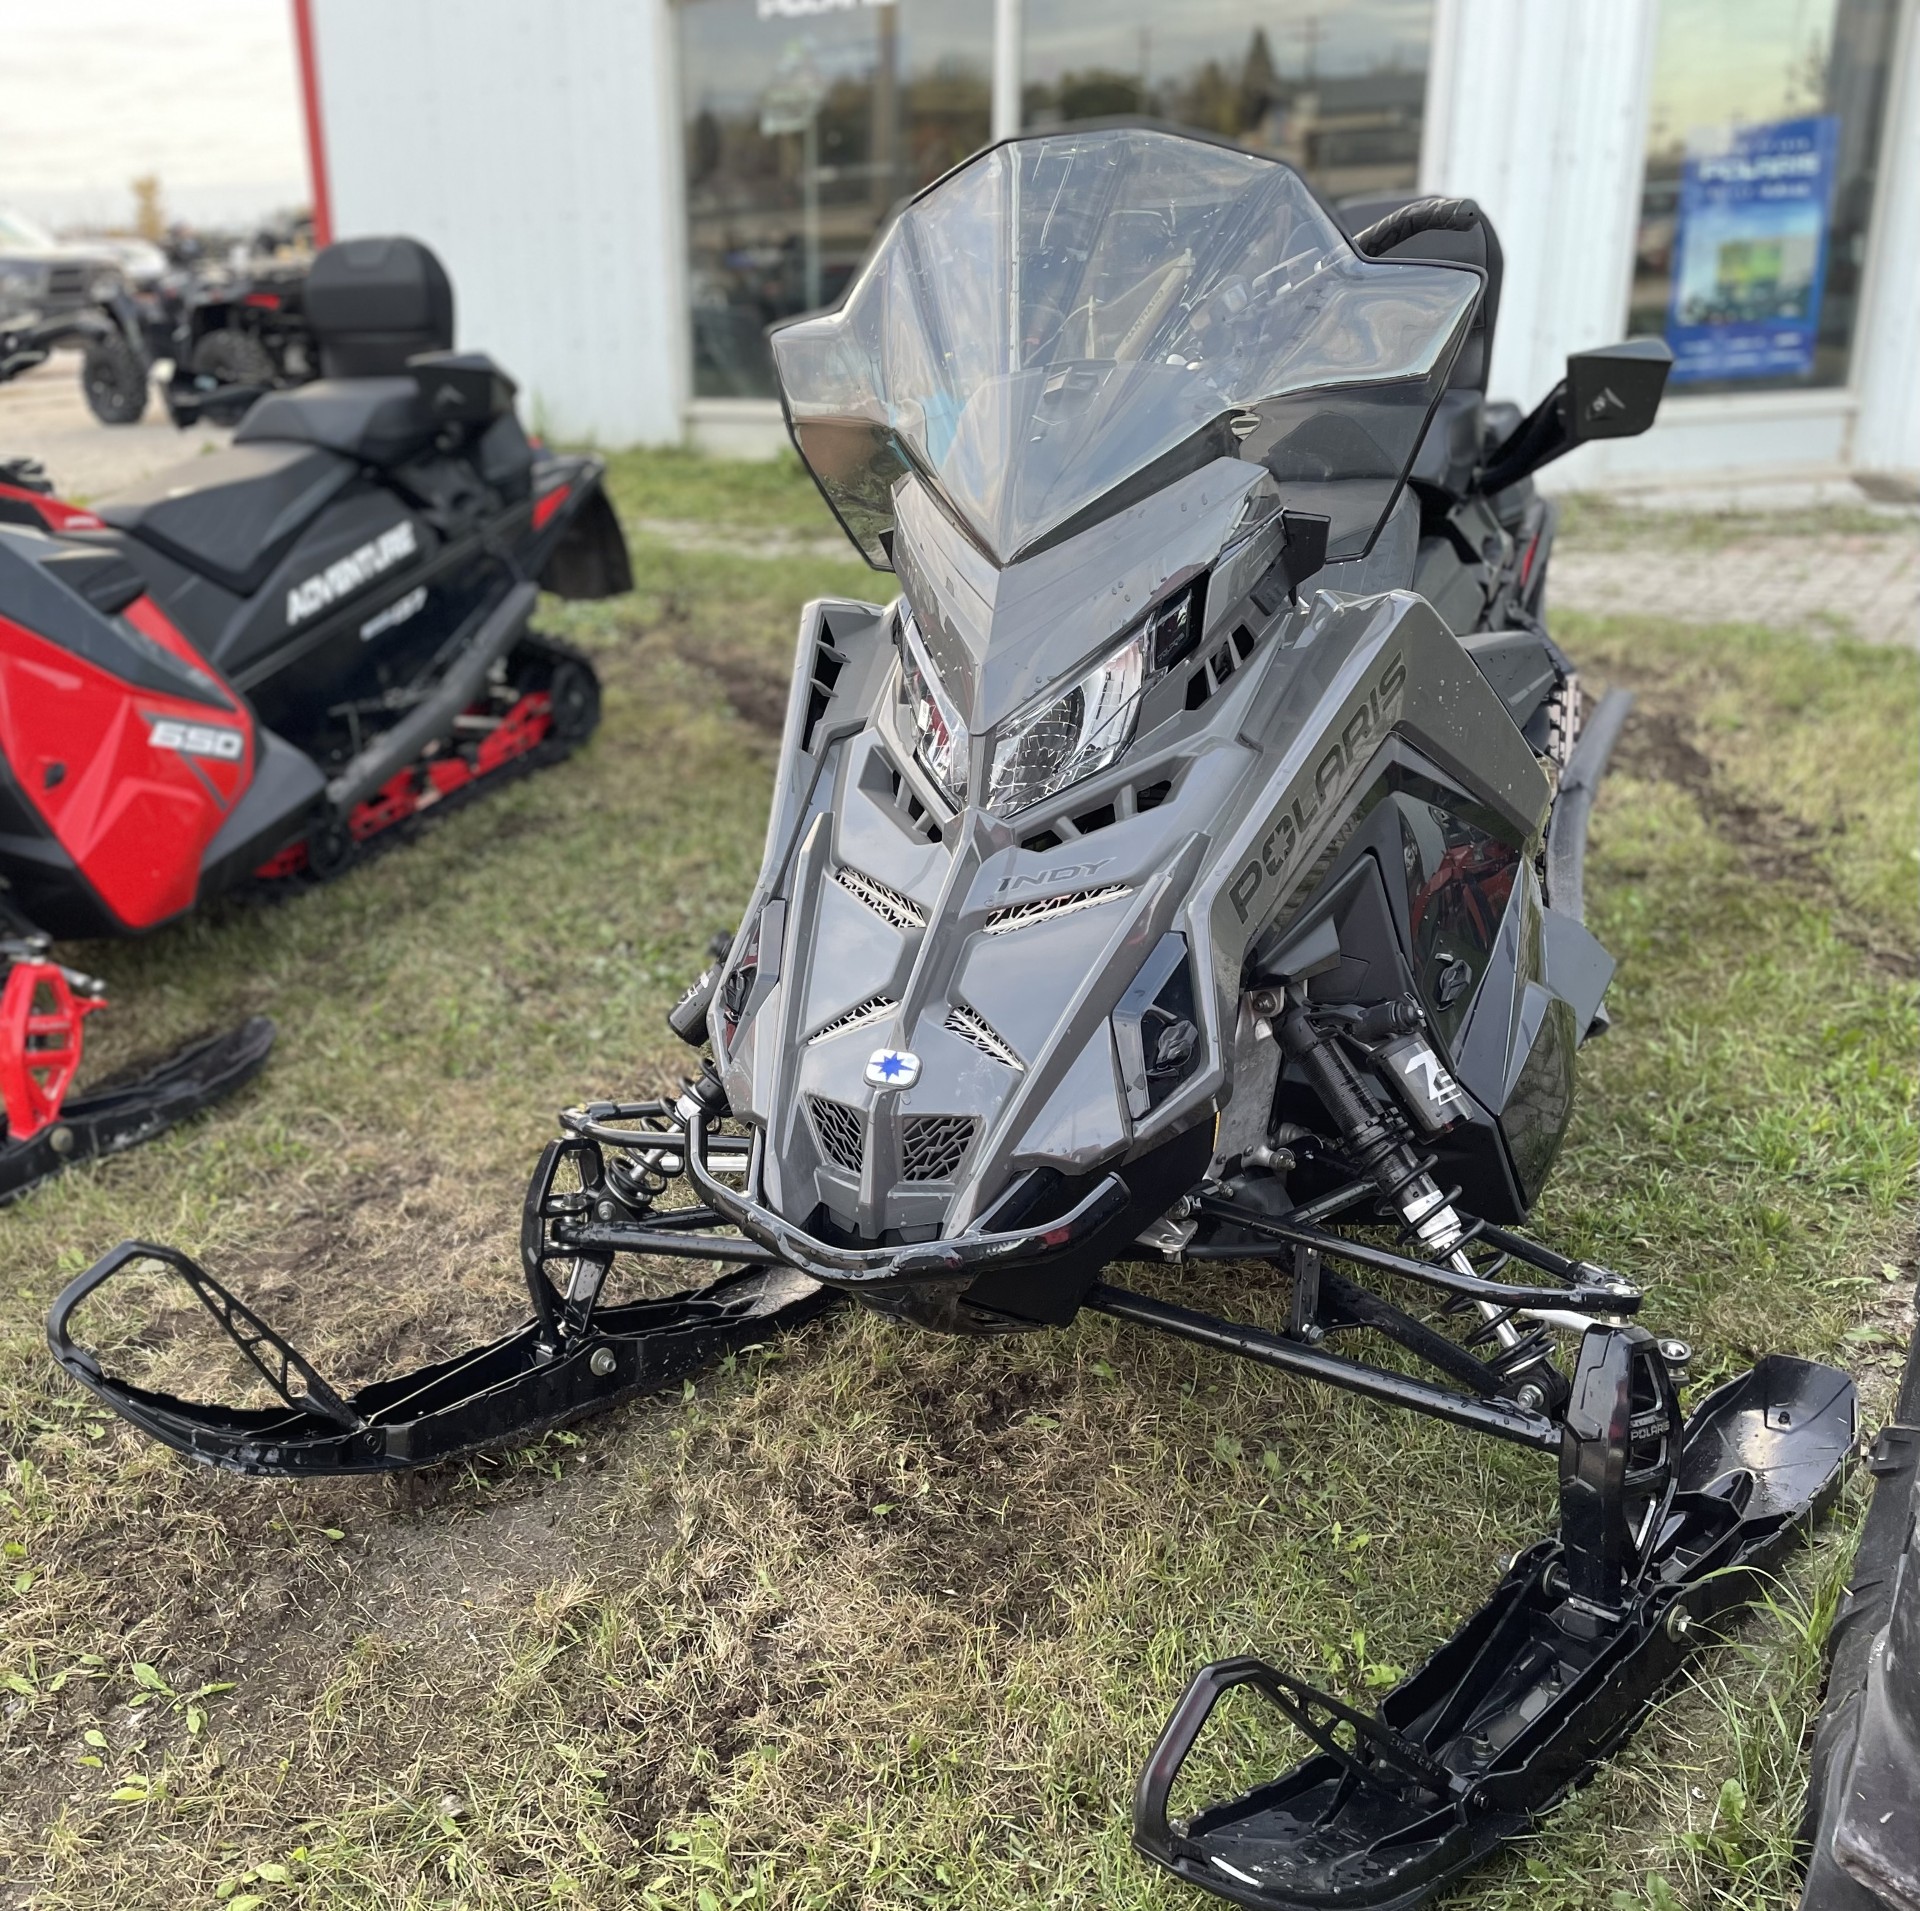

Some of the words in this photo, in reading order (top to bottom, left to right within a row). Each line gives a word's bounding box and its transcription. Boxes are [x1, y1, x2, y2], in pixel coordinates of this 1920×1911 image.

[286, 519, 417, 627] ADVENTURE
[146, 719, 244, 760] 650
[1227, 647, 1408, 925] POLARIS
[993, 856, 1118, 894] INDY
